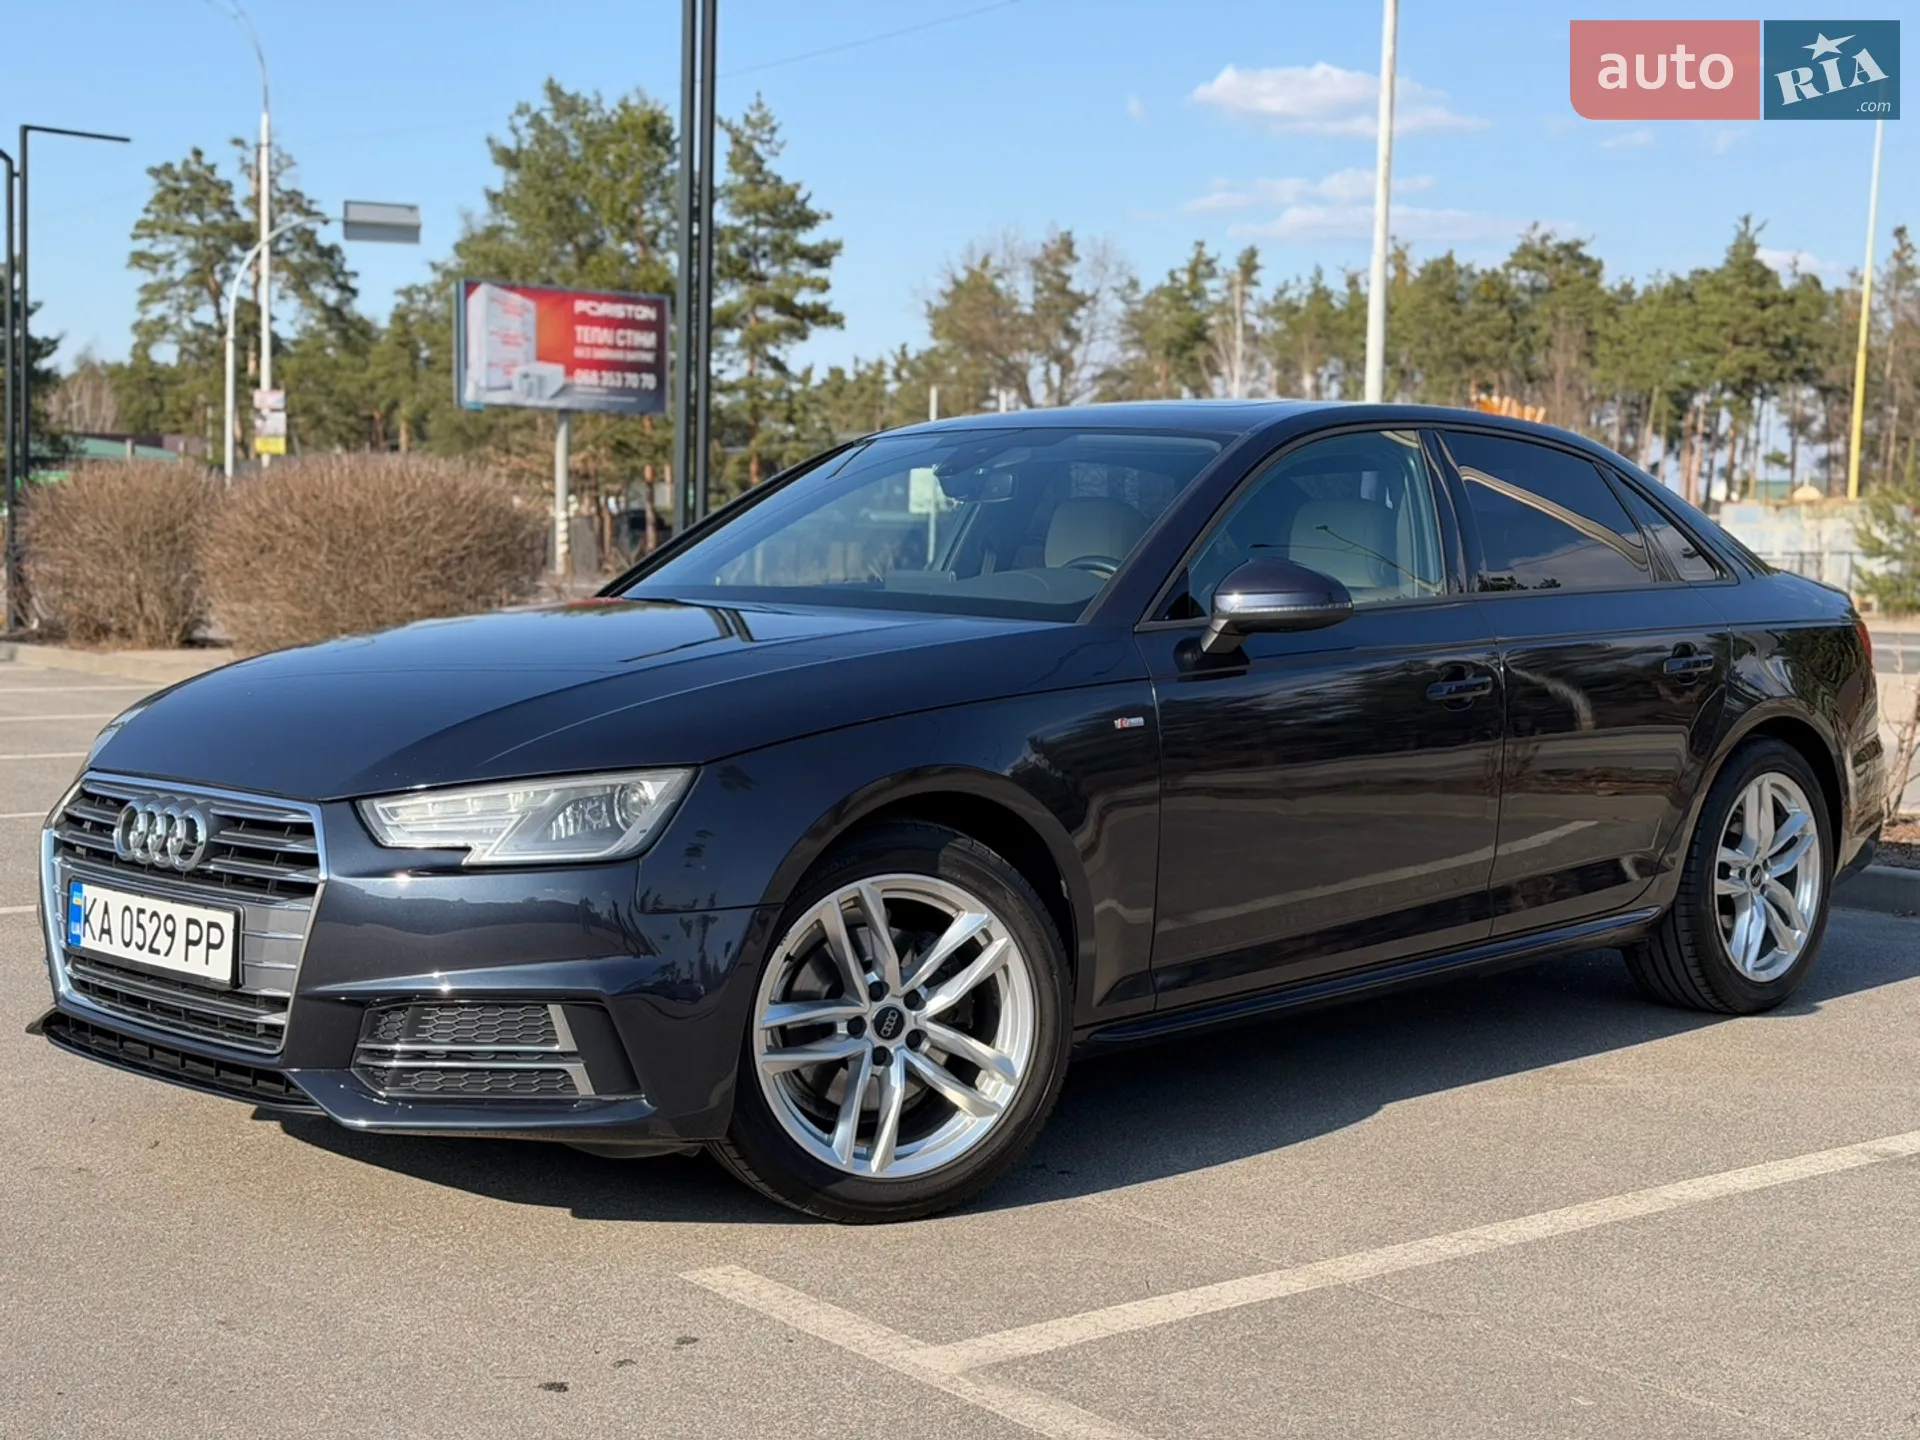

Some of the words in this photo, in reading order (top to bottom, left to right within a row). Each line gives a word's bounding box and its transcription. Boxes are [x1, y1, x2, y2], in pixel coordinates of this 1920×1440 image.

[83, 895, 113, 945] KA
[121, 905, 177, 957] 0529
[184, 917, 225, 965] PP
